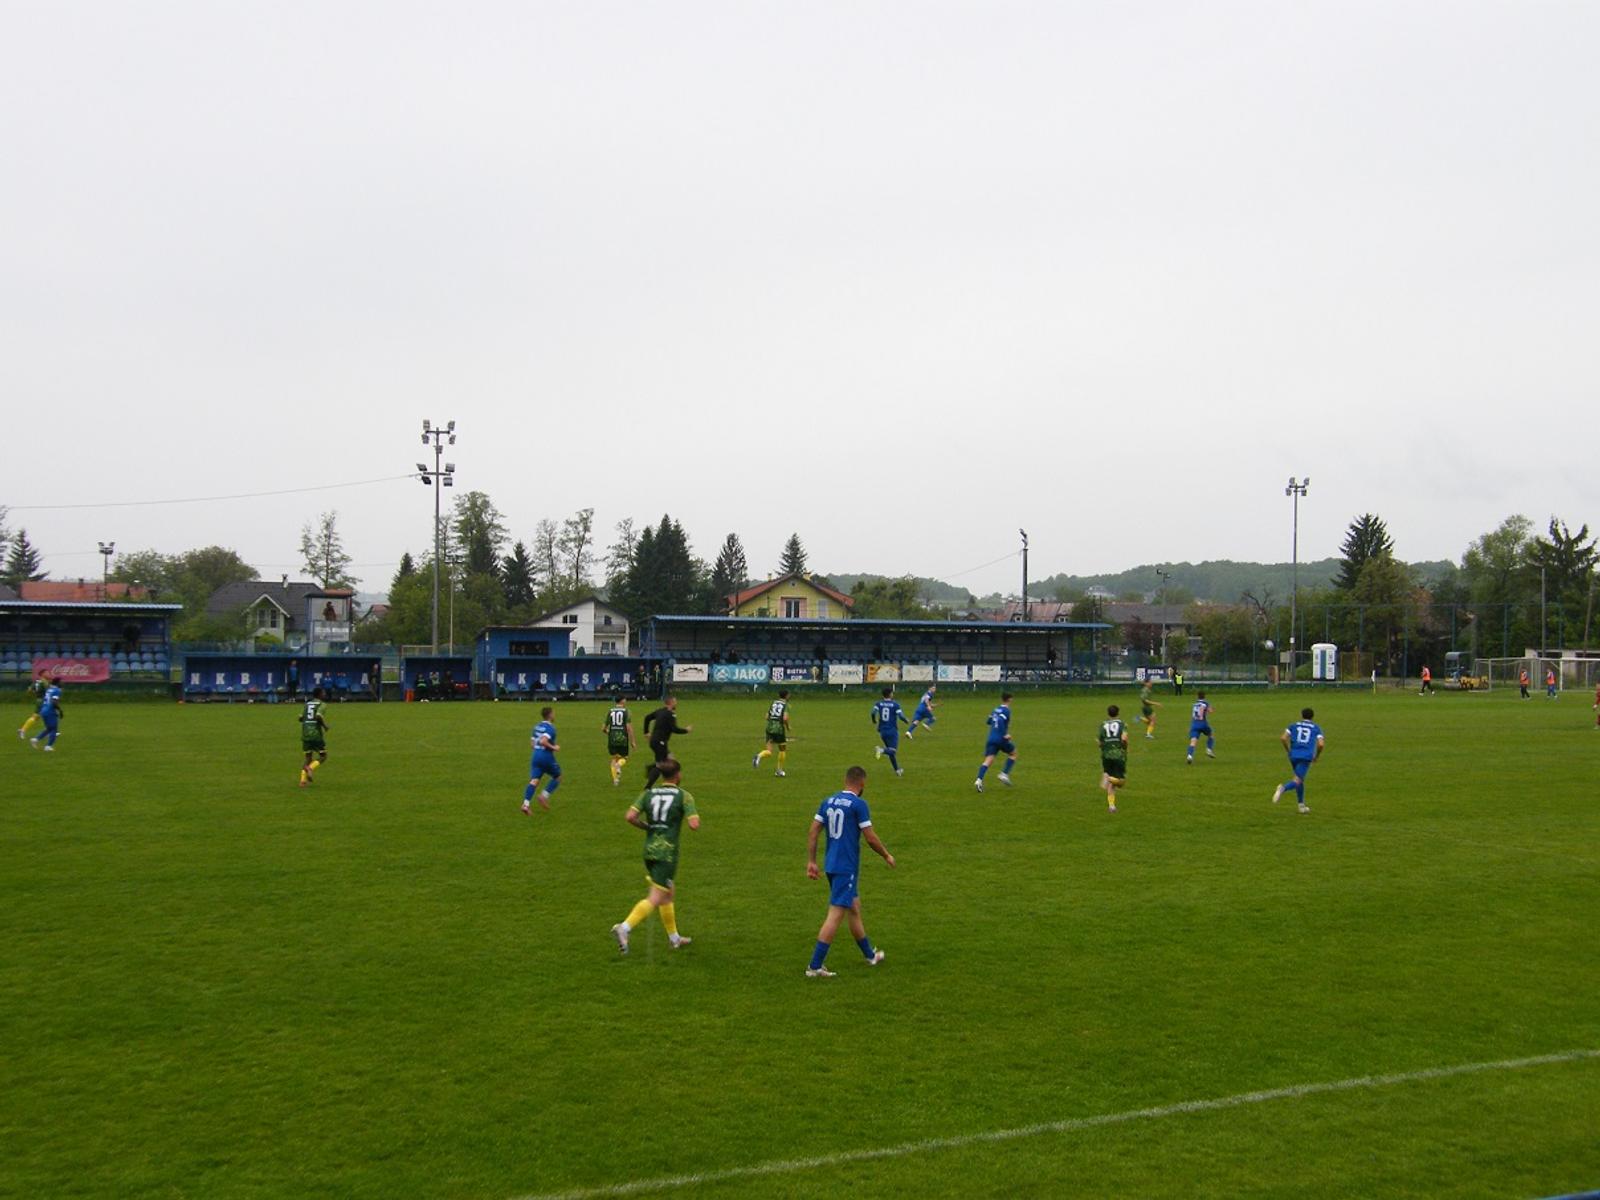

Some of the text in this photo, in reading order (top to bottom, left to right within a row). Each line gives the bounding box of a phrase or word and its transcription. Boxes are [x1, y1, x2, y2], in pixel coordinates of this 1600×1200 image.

[733, 667, 768, 680] JAKO
[307, 704, 316, 720] 5
[771, 703, 784, 717] 33
[881, 707, 890, 722] 8
[610, 711, 624, 726] 10
[1103, 721, 1120, 738] 19
[1296, 726, 1311, 743] 13
[650, 794, 675, 822] 17
[826, 807, 845, 840] 10
